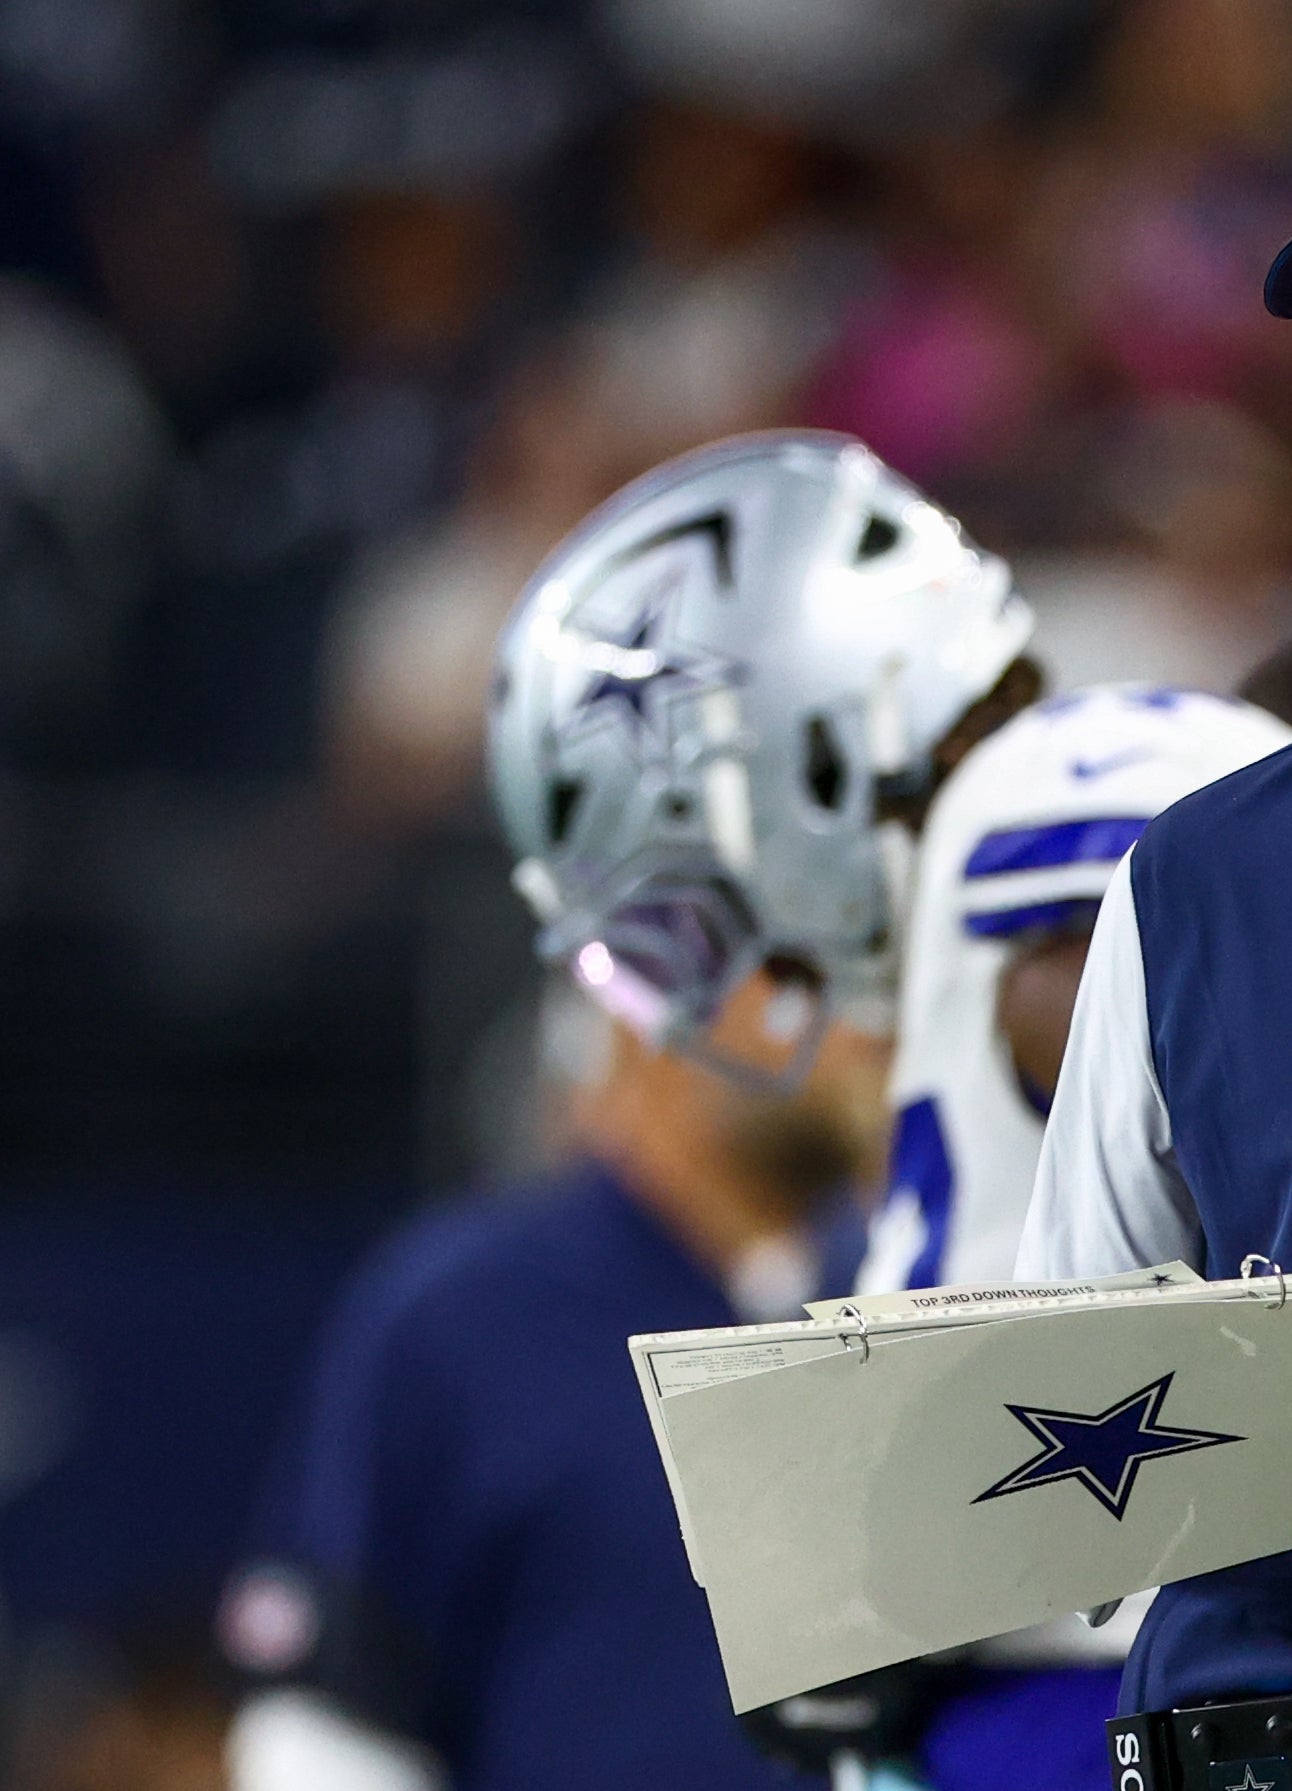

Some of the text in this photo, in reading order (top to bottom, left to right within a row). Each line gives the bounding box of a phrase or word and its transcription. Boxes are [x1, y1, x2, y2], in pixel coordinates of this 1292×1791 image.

[911, 1285, 1097, 1309] TOP 3RD DOWN THOUGHTS
